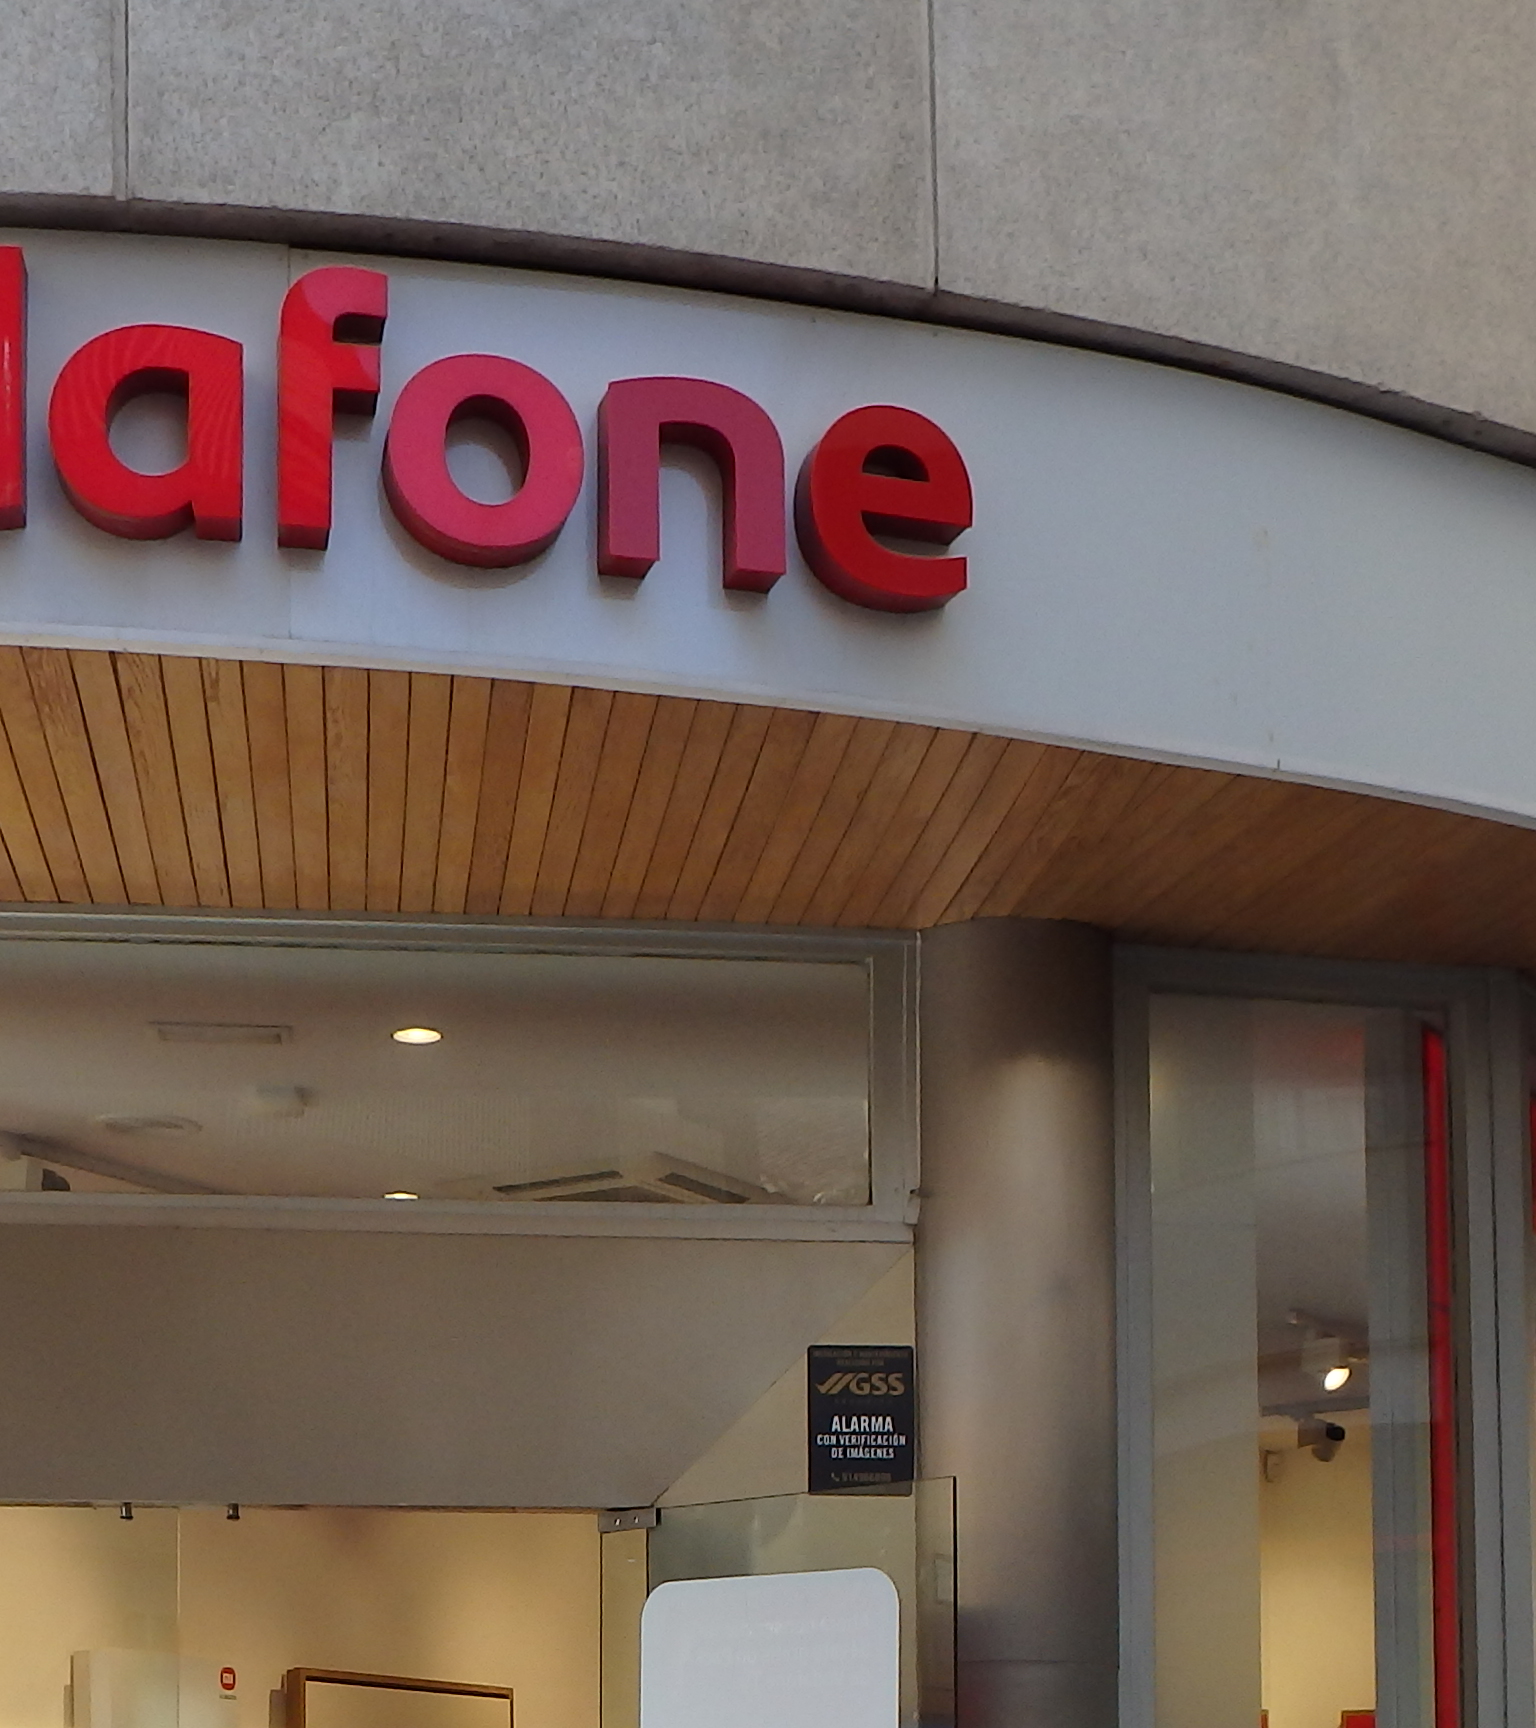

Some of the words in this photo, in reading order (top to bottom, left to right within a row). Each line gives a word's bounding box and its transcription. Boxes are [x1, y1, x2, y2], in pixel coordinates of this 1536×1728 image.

[849, 1372, 905, 1395] GSS
[831, 1416, 893, 1432] ALARMA
[817, 1435, 837, 1445] CON
[840, 1433, 906, 1446] VERIFICACIÓN
[831, 1448, 844, 1458] DE
[846, 1446, 894, 1459] IMÁGENES
